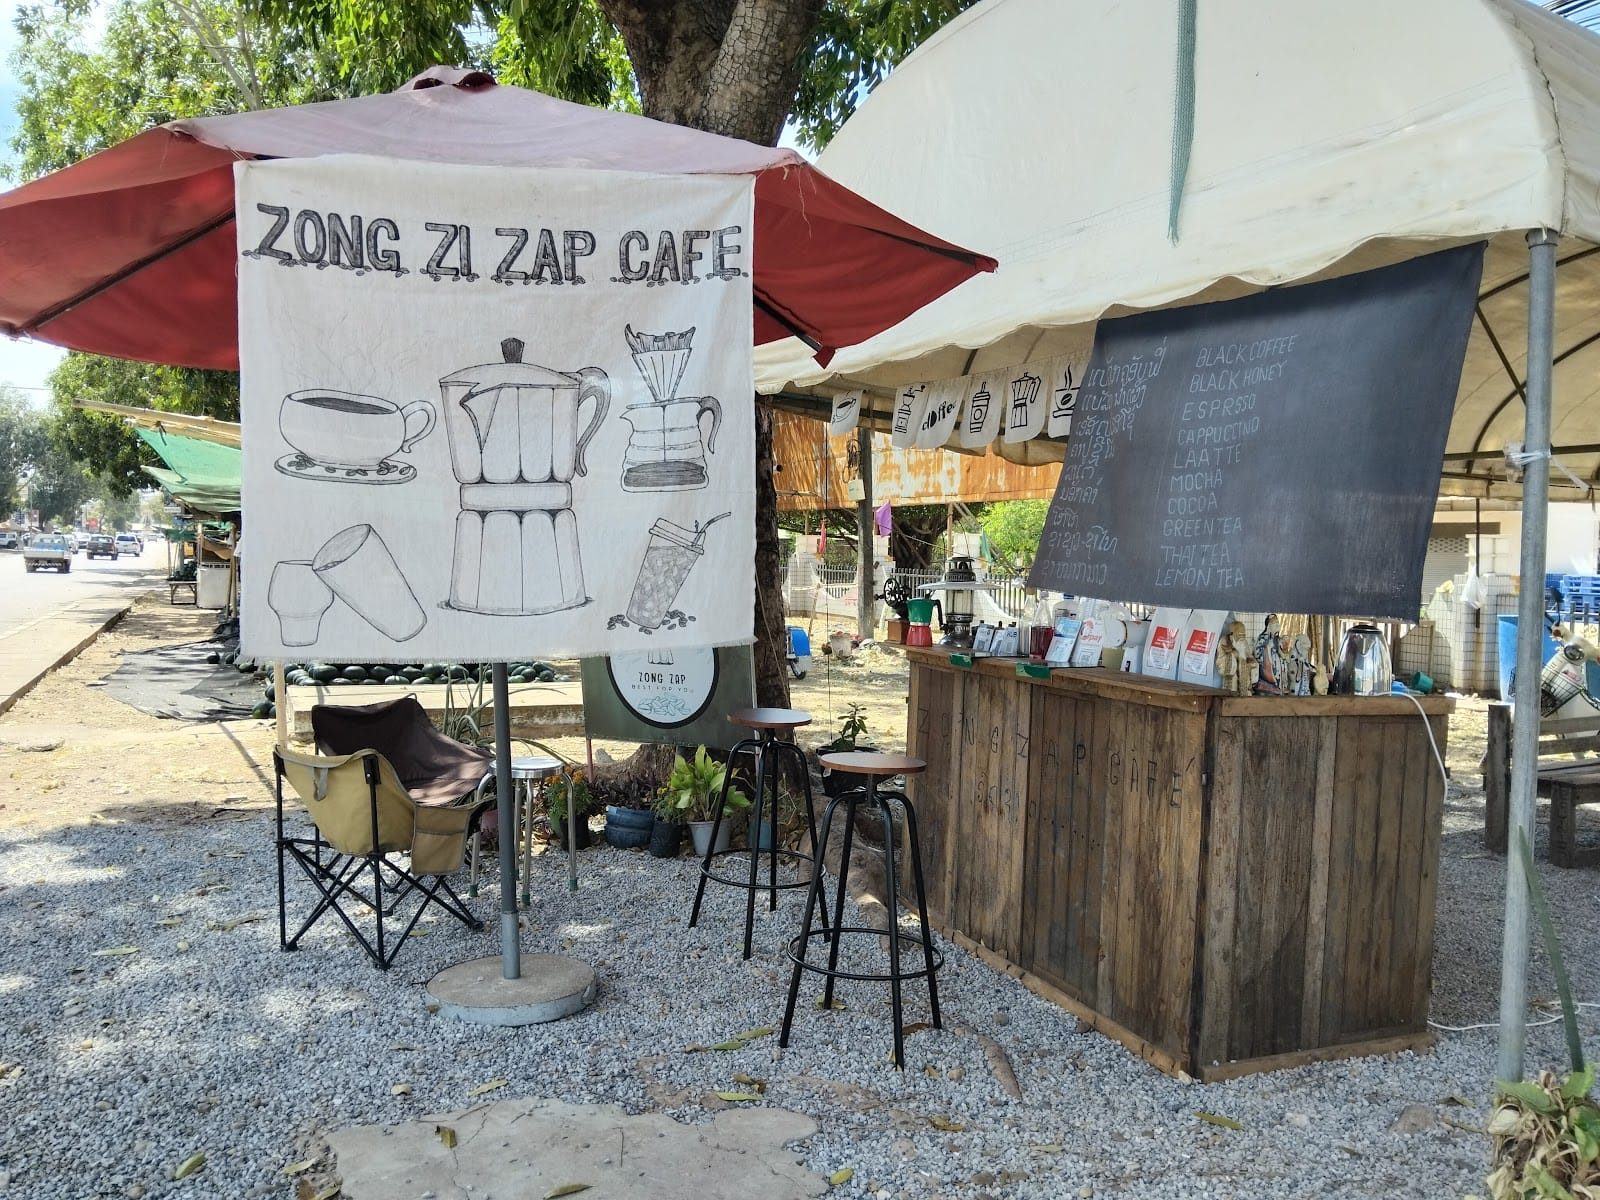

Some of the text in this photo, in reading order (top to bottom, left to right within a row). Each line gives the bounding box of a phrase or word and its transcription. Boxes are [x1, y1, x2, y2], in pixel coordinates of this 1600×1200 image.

[256, 202, 742, 281] ZONG ZI ZAP CAFE
[1195, 334, 1299, 368] BLACK COFFEE
[1189, 359, 1288, 393] BLACK HONEY
[1181, 393, 1257, 421] ESPRSSO
[1177, 416, 1260, 446] CAPPUCCINO
[1169, 468, 1223, 493] MOCHA
[1167, 491, 1218, 515] COCOA
[1162, 516, 1243, 538] GREEN TEA
[1159, 541, 1231, 567] THAI TEA
[1154, 567, 1245, 589] LEMON TEA
[638, 671, 686, 685] ZONG ZAP
[1015, 732, 1087, 776] ZAP
